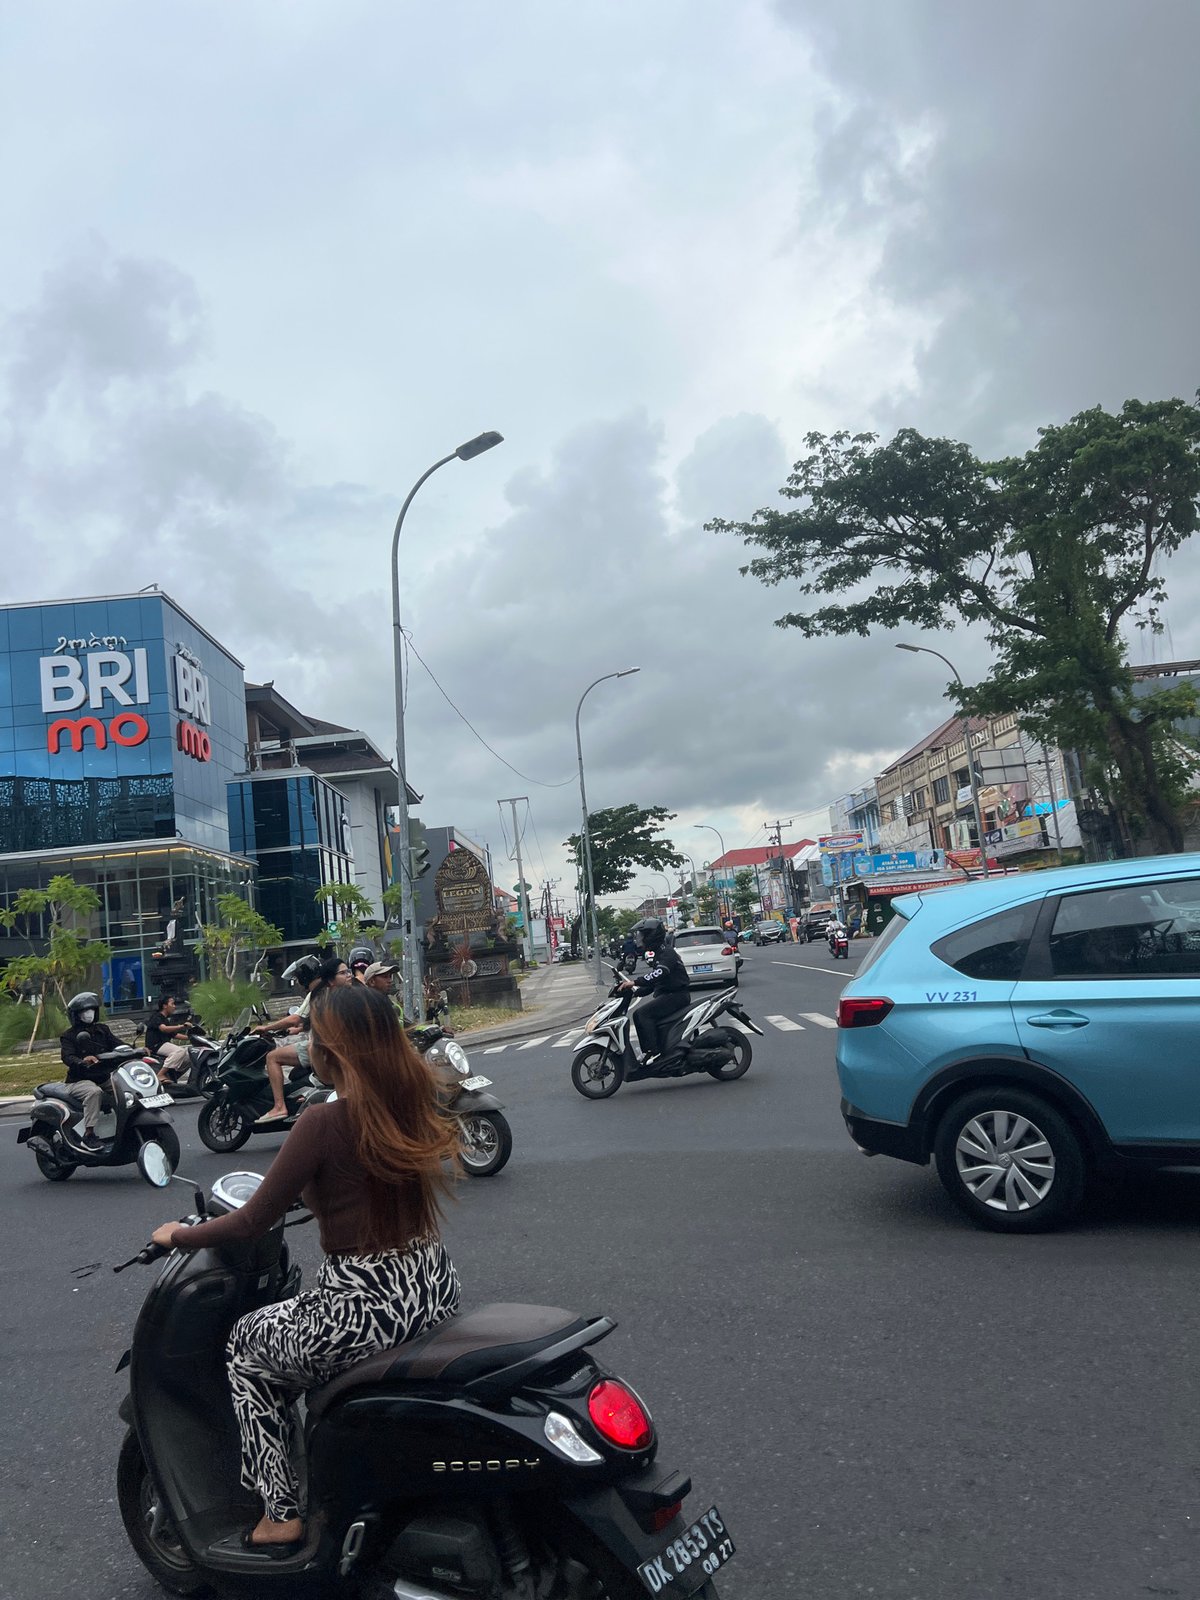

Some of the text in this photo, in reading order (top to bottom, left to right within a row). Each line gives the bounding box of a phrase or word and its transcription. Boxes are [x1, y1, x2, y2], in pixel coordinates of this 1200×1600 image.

[40, 647, 150, 713] BRI
[173, 655, 211, 727] BRI
[48, 711, 149, 754] mo
[442, 886, 482, 898] LEGIAN
[869, 886, 892, 894] SAMBAL
[952, 990, 978, 1003] 231
[643, 1508, 724, 1592] DK 2853 TS
[719, 1538, 733, 1560] 27
